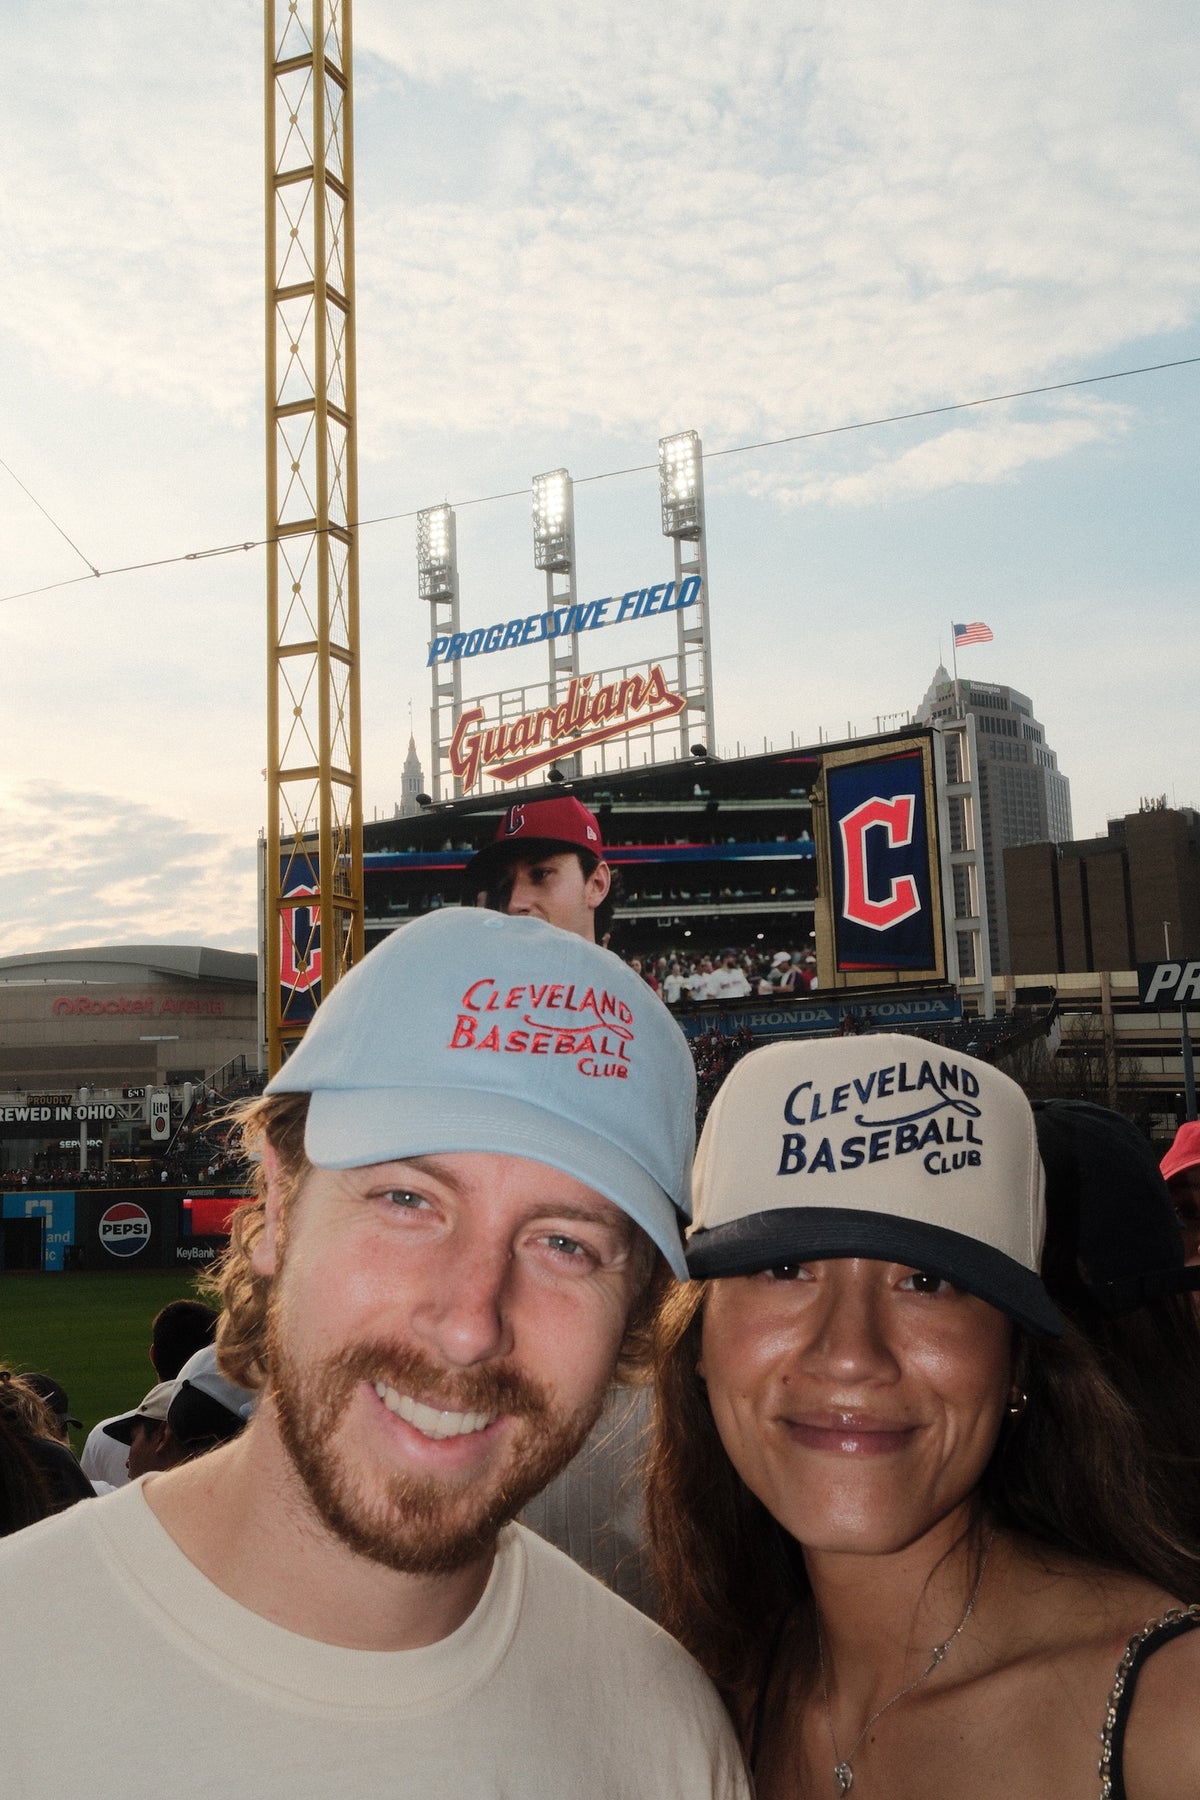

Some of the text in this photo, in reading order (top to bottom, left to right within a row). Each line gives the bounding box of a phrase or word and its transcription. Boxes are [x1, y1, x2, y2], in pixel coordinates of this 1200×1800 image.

[427, 575, 703, 668] PROGRESSIVE FIELD
[448, 664, 687, 795] Guardians
[77, 995, 225, 1015] Rocket Arena
[461, 978, 634, 1030] CLEVELAND
[861, 1000, 950, 1018] HONDA
[750, 1009, 833, 1026] HONDA
[447, 1014, 632, 1062] BASEBALL
[577, 1057, 629, 1080] CLUB
[27, 1095, 72, 1105] PROUDLY
[783, 1060, 982, 1127] CLEVELAND
[55, 1106, 72, 1121] IN
[76, 1104, 116, 1120] OHIO
[153, 1102, 168, 1116] Lite
[777, 1115, 984, 1177] BASEBALL
[923, 1149, 982, 1176] CLUB
[102, 1222, 148, 1235] PEPSI
[176, 1247, 215, 1260] KeyBank
